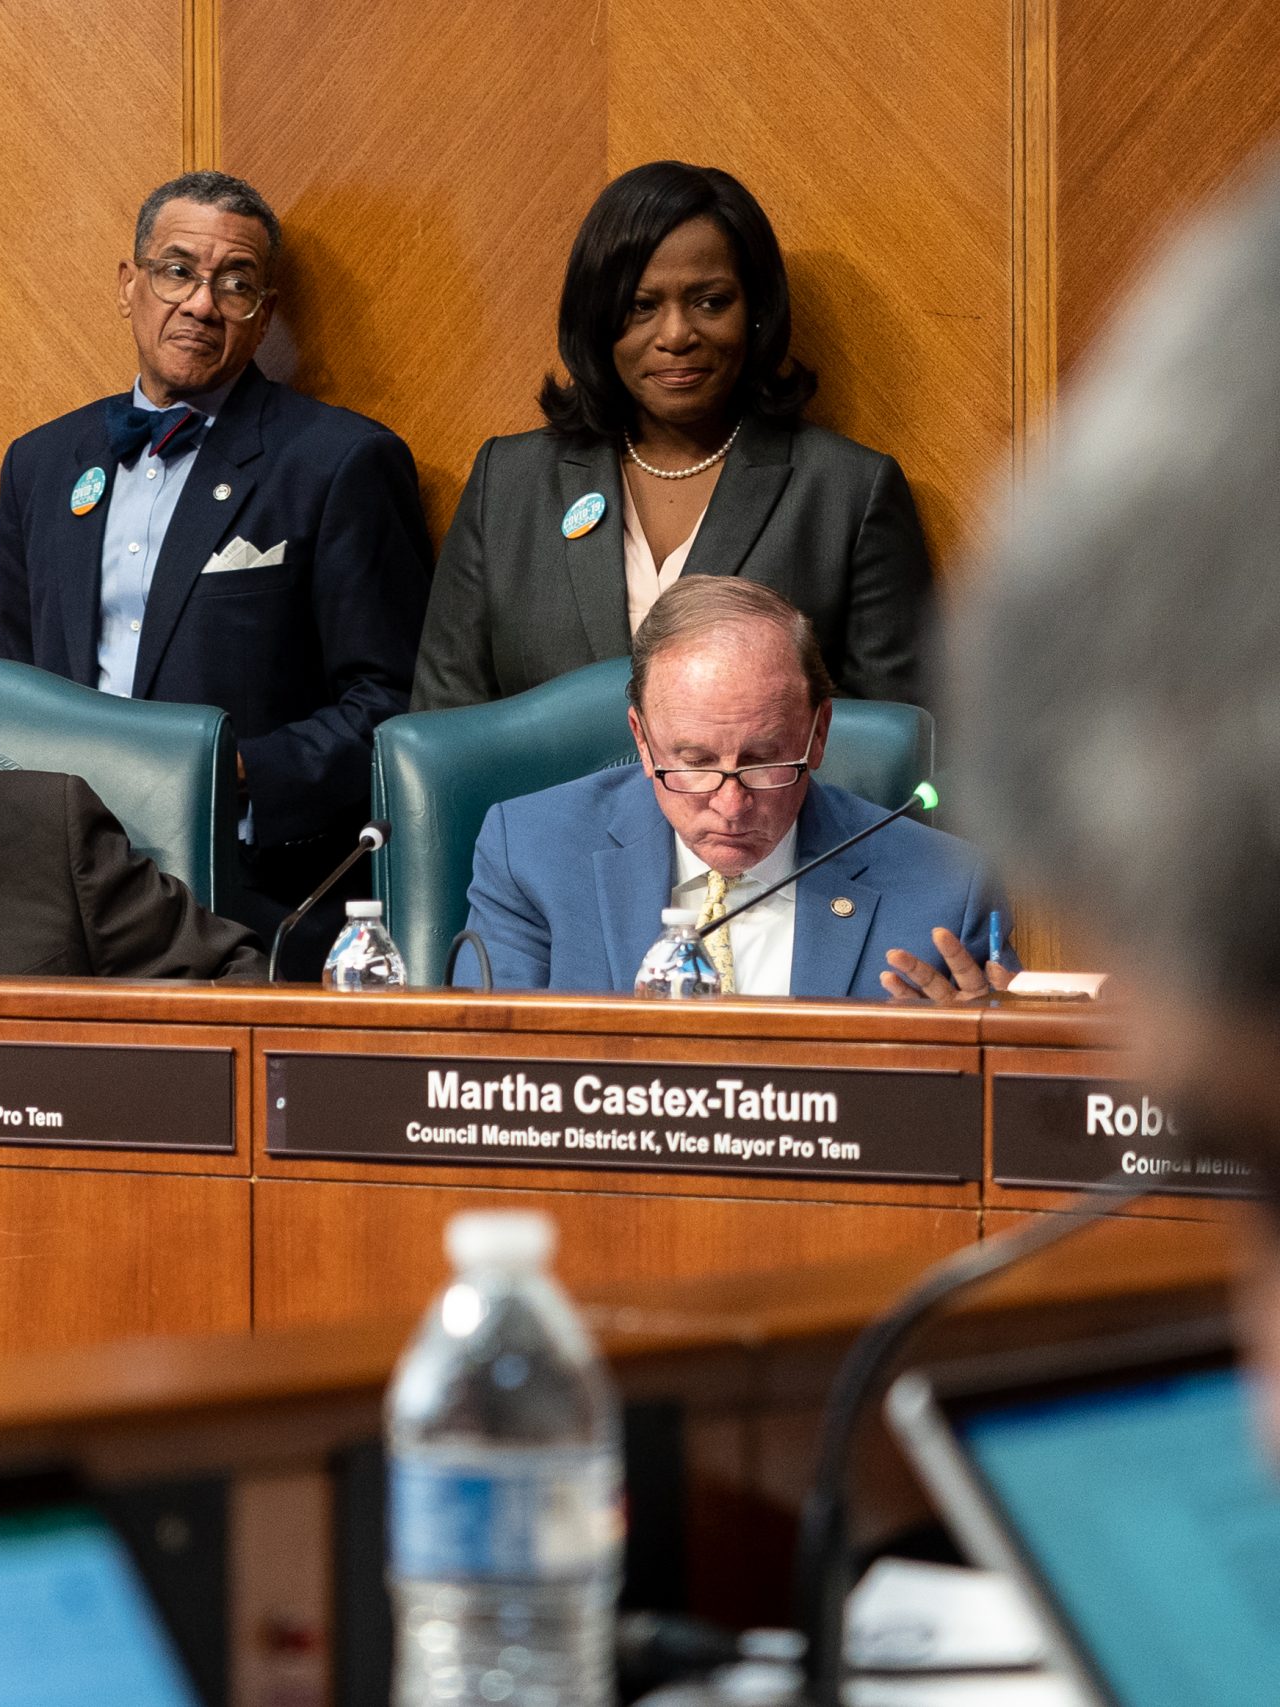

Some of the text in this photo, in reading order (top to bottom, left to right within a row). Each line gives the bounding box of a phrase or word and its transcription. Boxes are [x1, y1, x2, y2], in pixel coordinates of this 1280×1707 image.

[24, 1107, 63, 1128] Tem
[427, 1069, 838, 1124] Martha Castex-Tatum
[1086, 1092, 1181, 1137] Rob
[405, 1121, 861, 1160] Council Member District K, Vice Mayor Pro Tem
